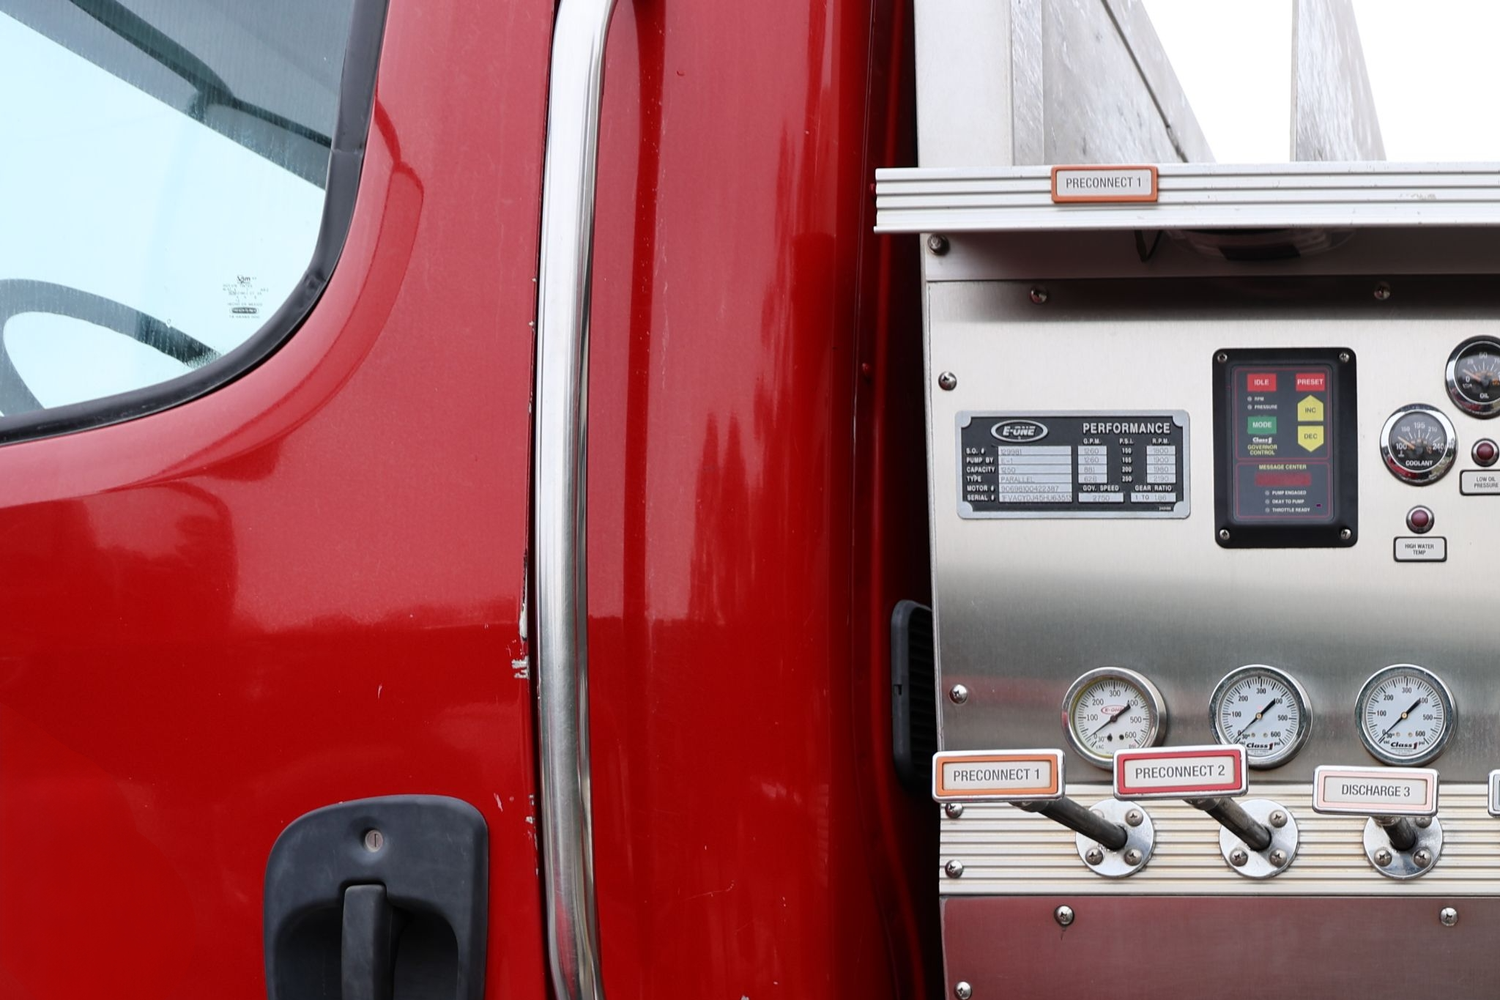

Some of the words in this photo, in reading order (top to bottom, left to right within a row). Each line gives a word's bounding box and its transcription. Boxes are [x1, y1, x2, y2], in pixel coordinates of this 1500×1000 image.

[1066, 177, 1133, 189] PRECONNECT
[1138, 178, 1141, 187] 1
[1002, 426, 1036, 436] E-ONE
[1083, 422, 1171, 434] PERFORMANCE
[953, 768, 1031, 782] PRECONNECT
[1035, 768, 1040, 780] 1
[1135, 765, 1215, 779] PRECONNECT
[1218, 765, 1225, 776] 2
[1341, 784, 1401, 797] DISCHARGE
[1404, 786, 1410, 797] 3
